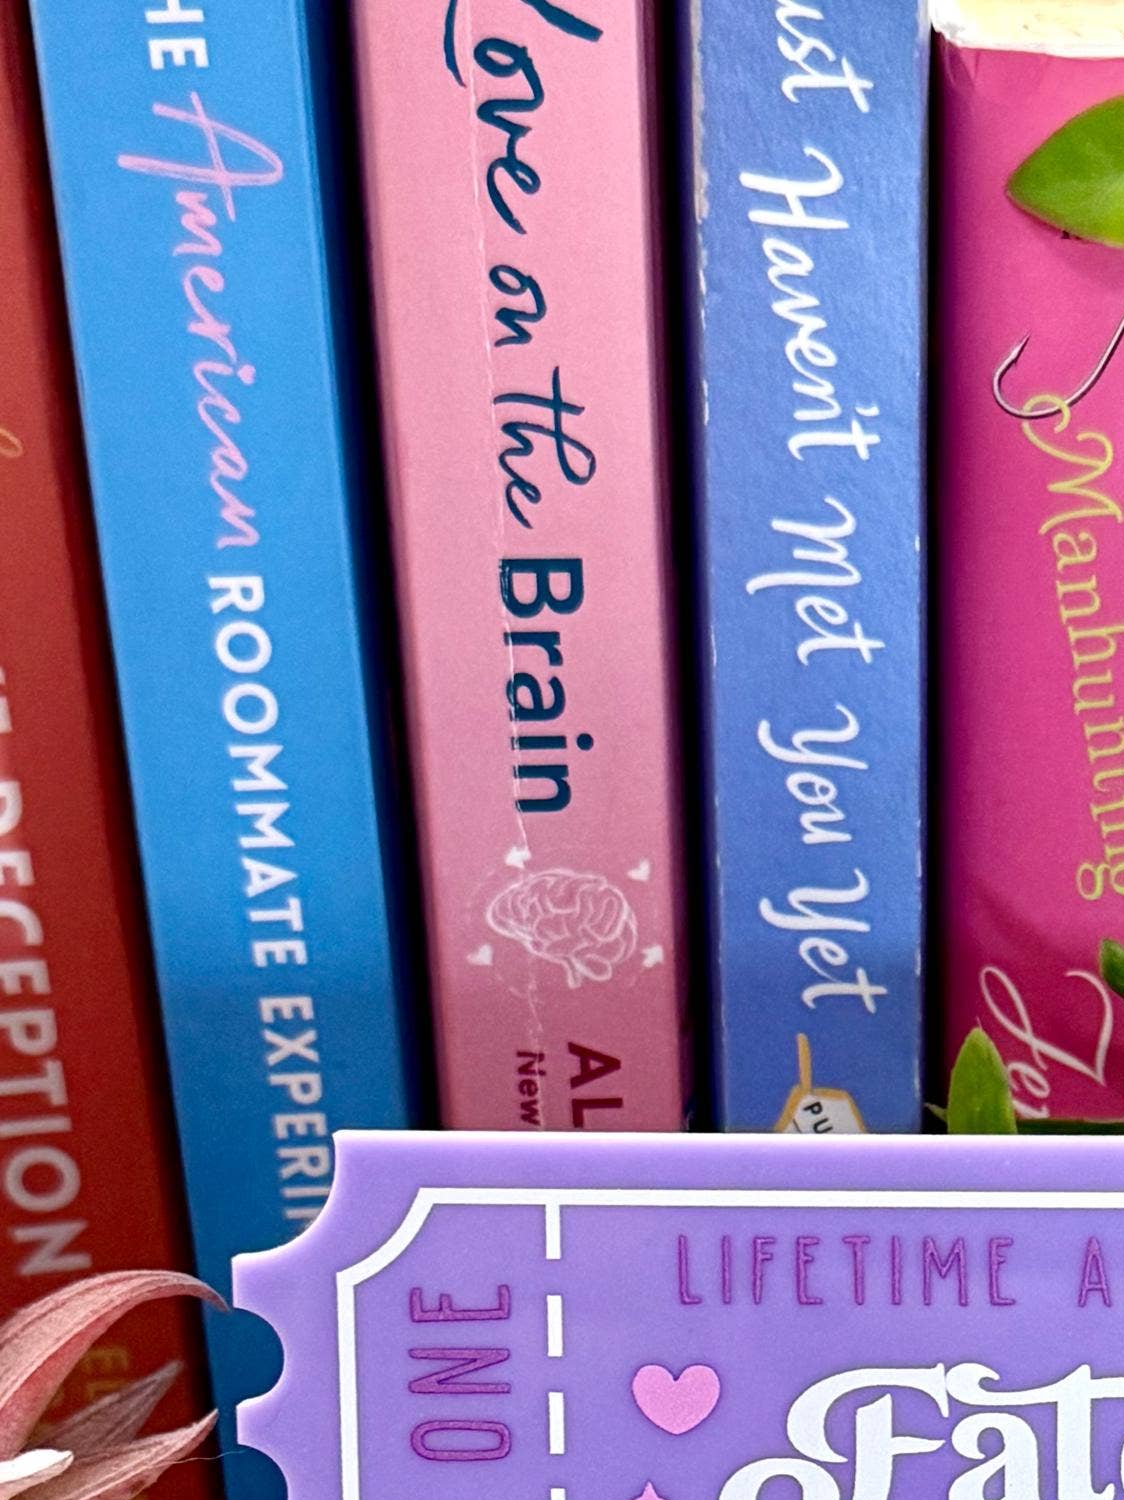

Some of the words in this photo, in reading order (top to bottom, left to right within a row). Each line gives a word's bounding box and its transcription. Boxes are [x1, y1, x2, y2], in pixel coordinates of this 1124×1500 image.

[489, 264, 547, 347] on
[738, 145, 881, 461] Haven't
[118, 92, 283, 548] American
[207, 575, 306, 966] ROOMMATE
[493, 366, 596, 529] the
[745, 496, 885, 666] Met
[499, 557, 594, 813] Brain
[757, 704, 868, 844] You
[759, 868, 887, 1013] Yet
[516, 1050, 547, 1126] New
[676, 1233, 1017, 1307] LIFETIME
[407, 1283, 514, 1464] ONE
